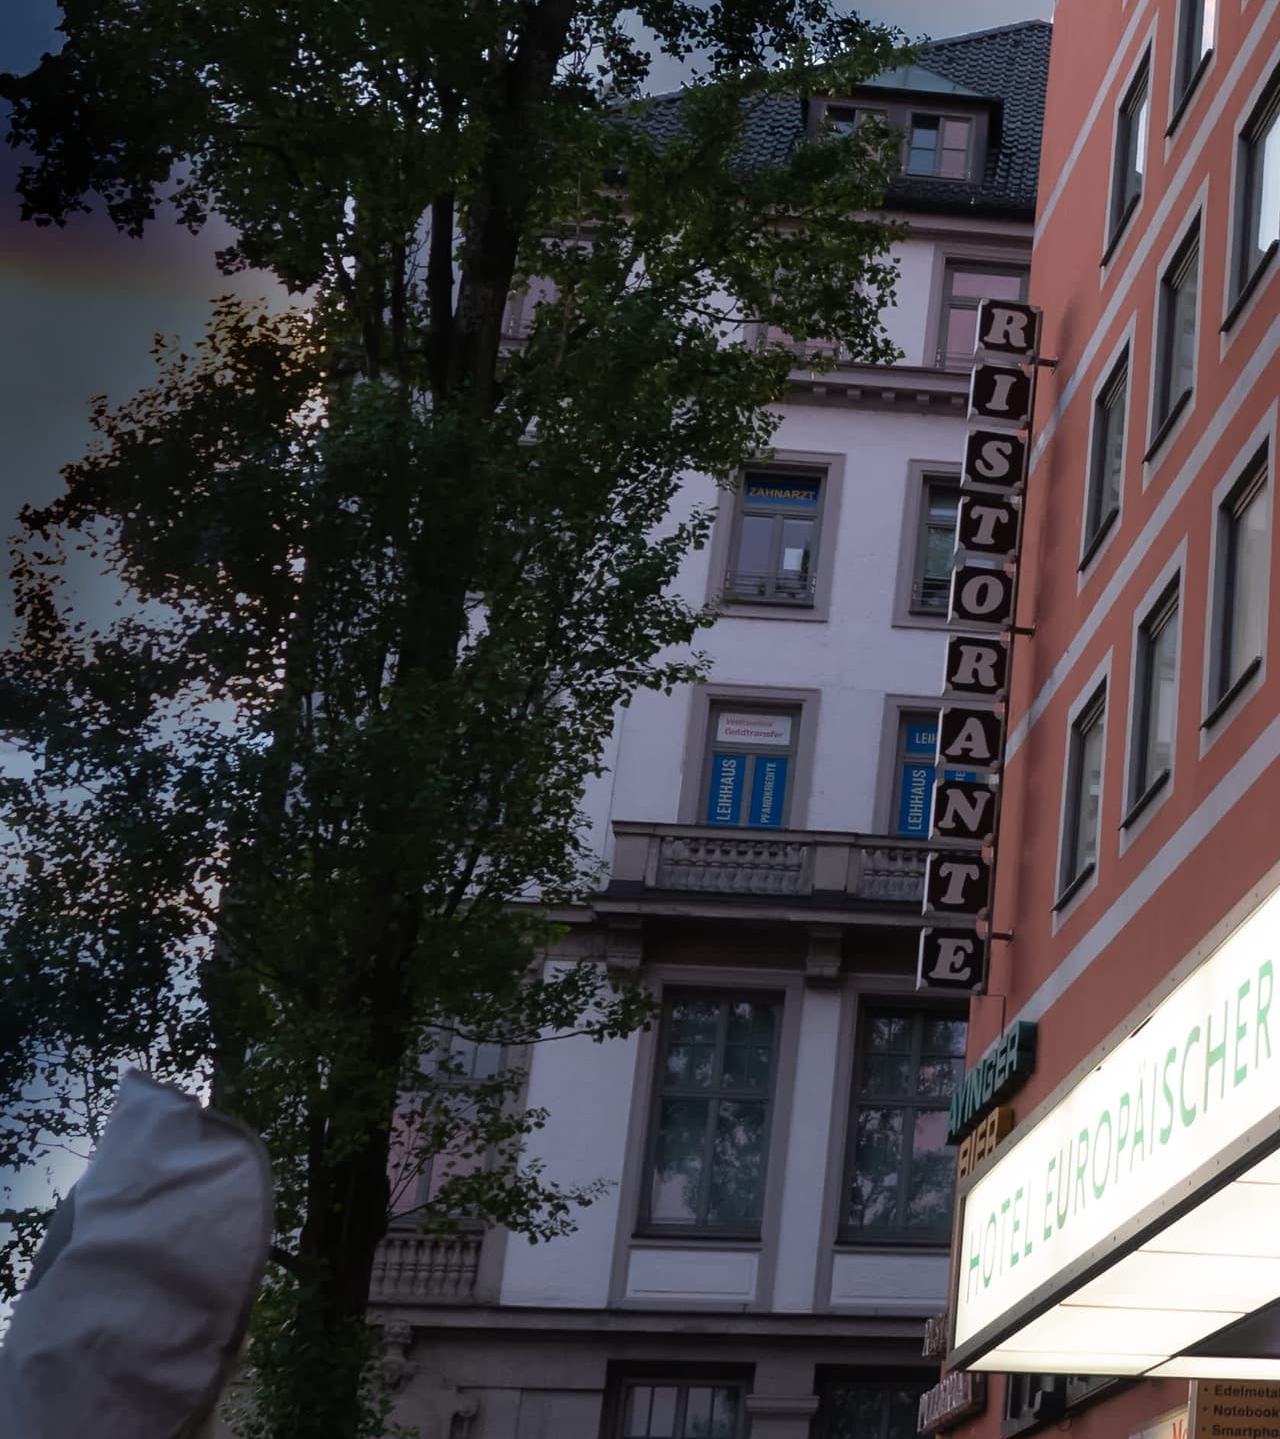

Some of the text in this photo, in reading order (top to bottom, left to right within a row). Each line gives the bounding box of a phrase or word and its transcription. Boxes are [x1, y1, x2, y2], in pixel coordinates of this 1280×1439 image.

[749, 487, 817, 501] ZAHNARZT
[931, 306, 1030, 983] RISTORANTE
[716, 759, 737, 821] LEIHHAUS
[907, 770, 927, 831] LEIHHAUS
[948, 1022, 1020, 1137] AYINGER
[957, 1107, 1001, 1179] BIER
[966, 1178, 1034, 1304] HOTEL
[1043, 959, 1275, 1242] EUROPÄISCHER
